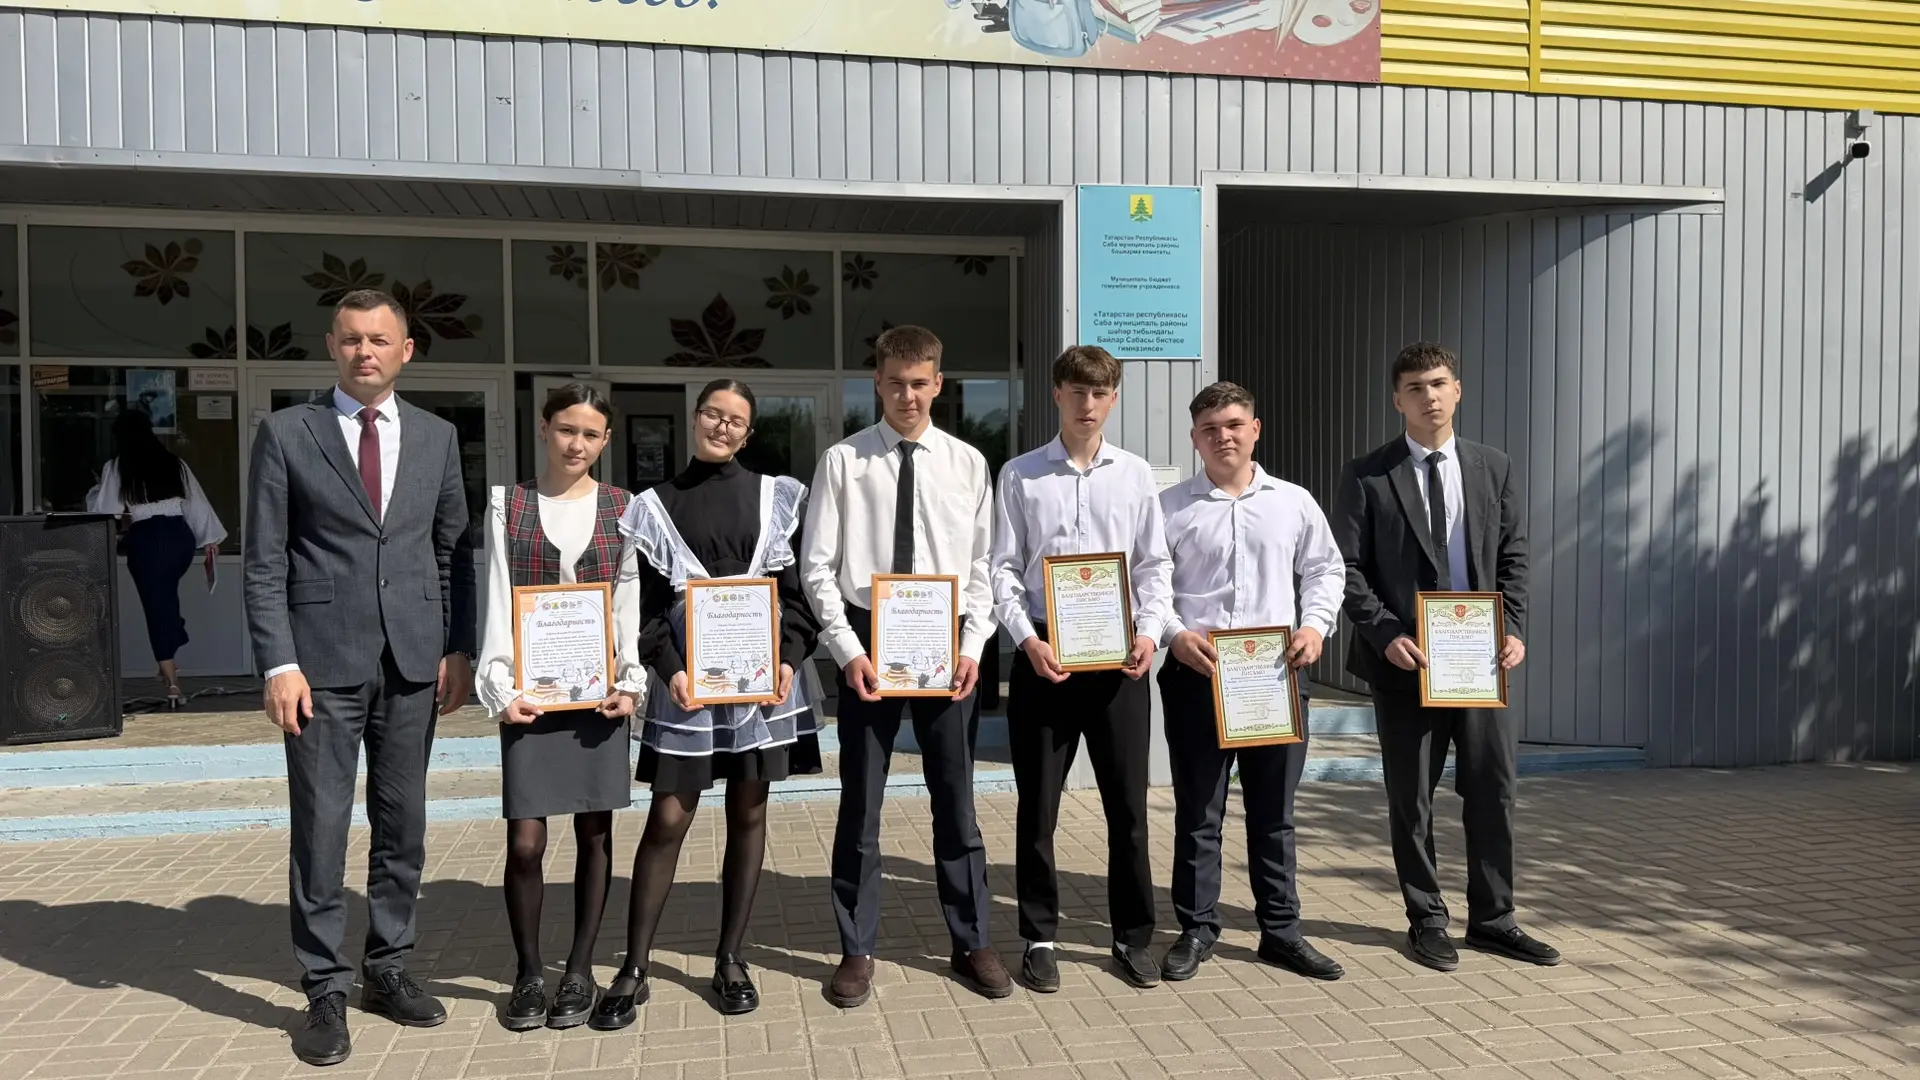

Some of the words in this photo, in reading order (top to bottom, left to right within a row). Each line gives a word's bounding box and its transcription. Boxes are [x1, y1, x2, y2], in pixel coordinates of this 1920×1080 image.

[1104, 234, 1134, 242] Татарстан
[1110, 275, 1148, 283] Муниципаль
[1093, 310, 1135, 319] «Татарстан
[1136, 311, 1188, 319] республикасы
[1113, 320, 1159, 328] муниципаль
[1132, 328, 1174, 336] тибындагы
[1096, 336, 1125, 344] Байлар
[1061, 590, 1115, 599] БЛАГОДАРСТВЕННОЕ
[706, 611, 763, 621] Благодарность
[891, 607, 944, 617] Благодарность
[535, 618, 596, 629] Благодарность
